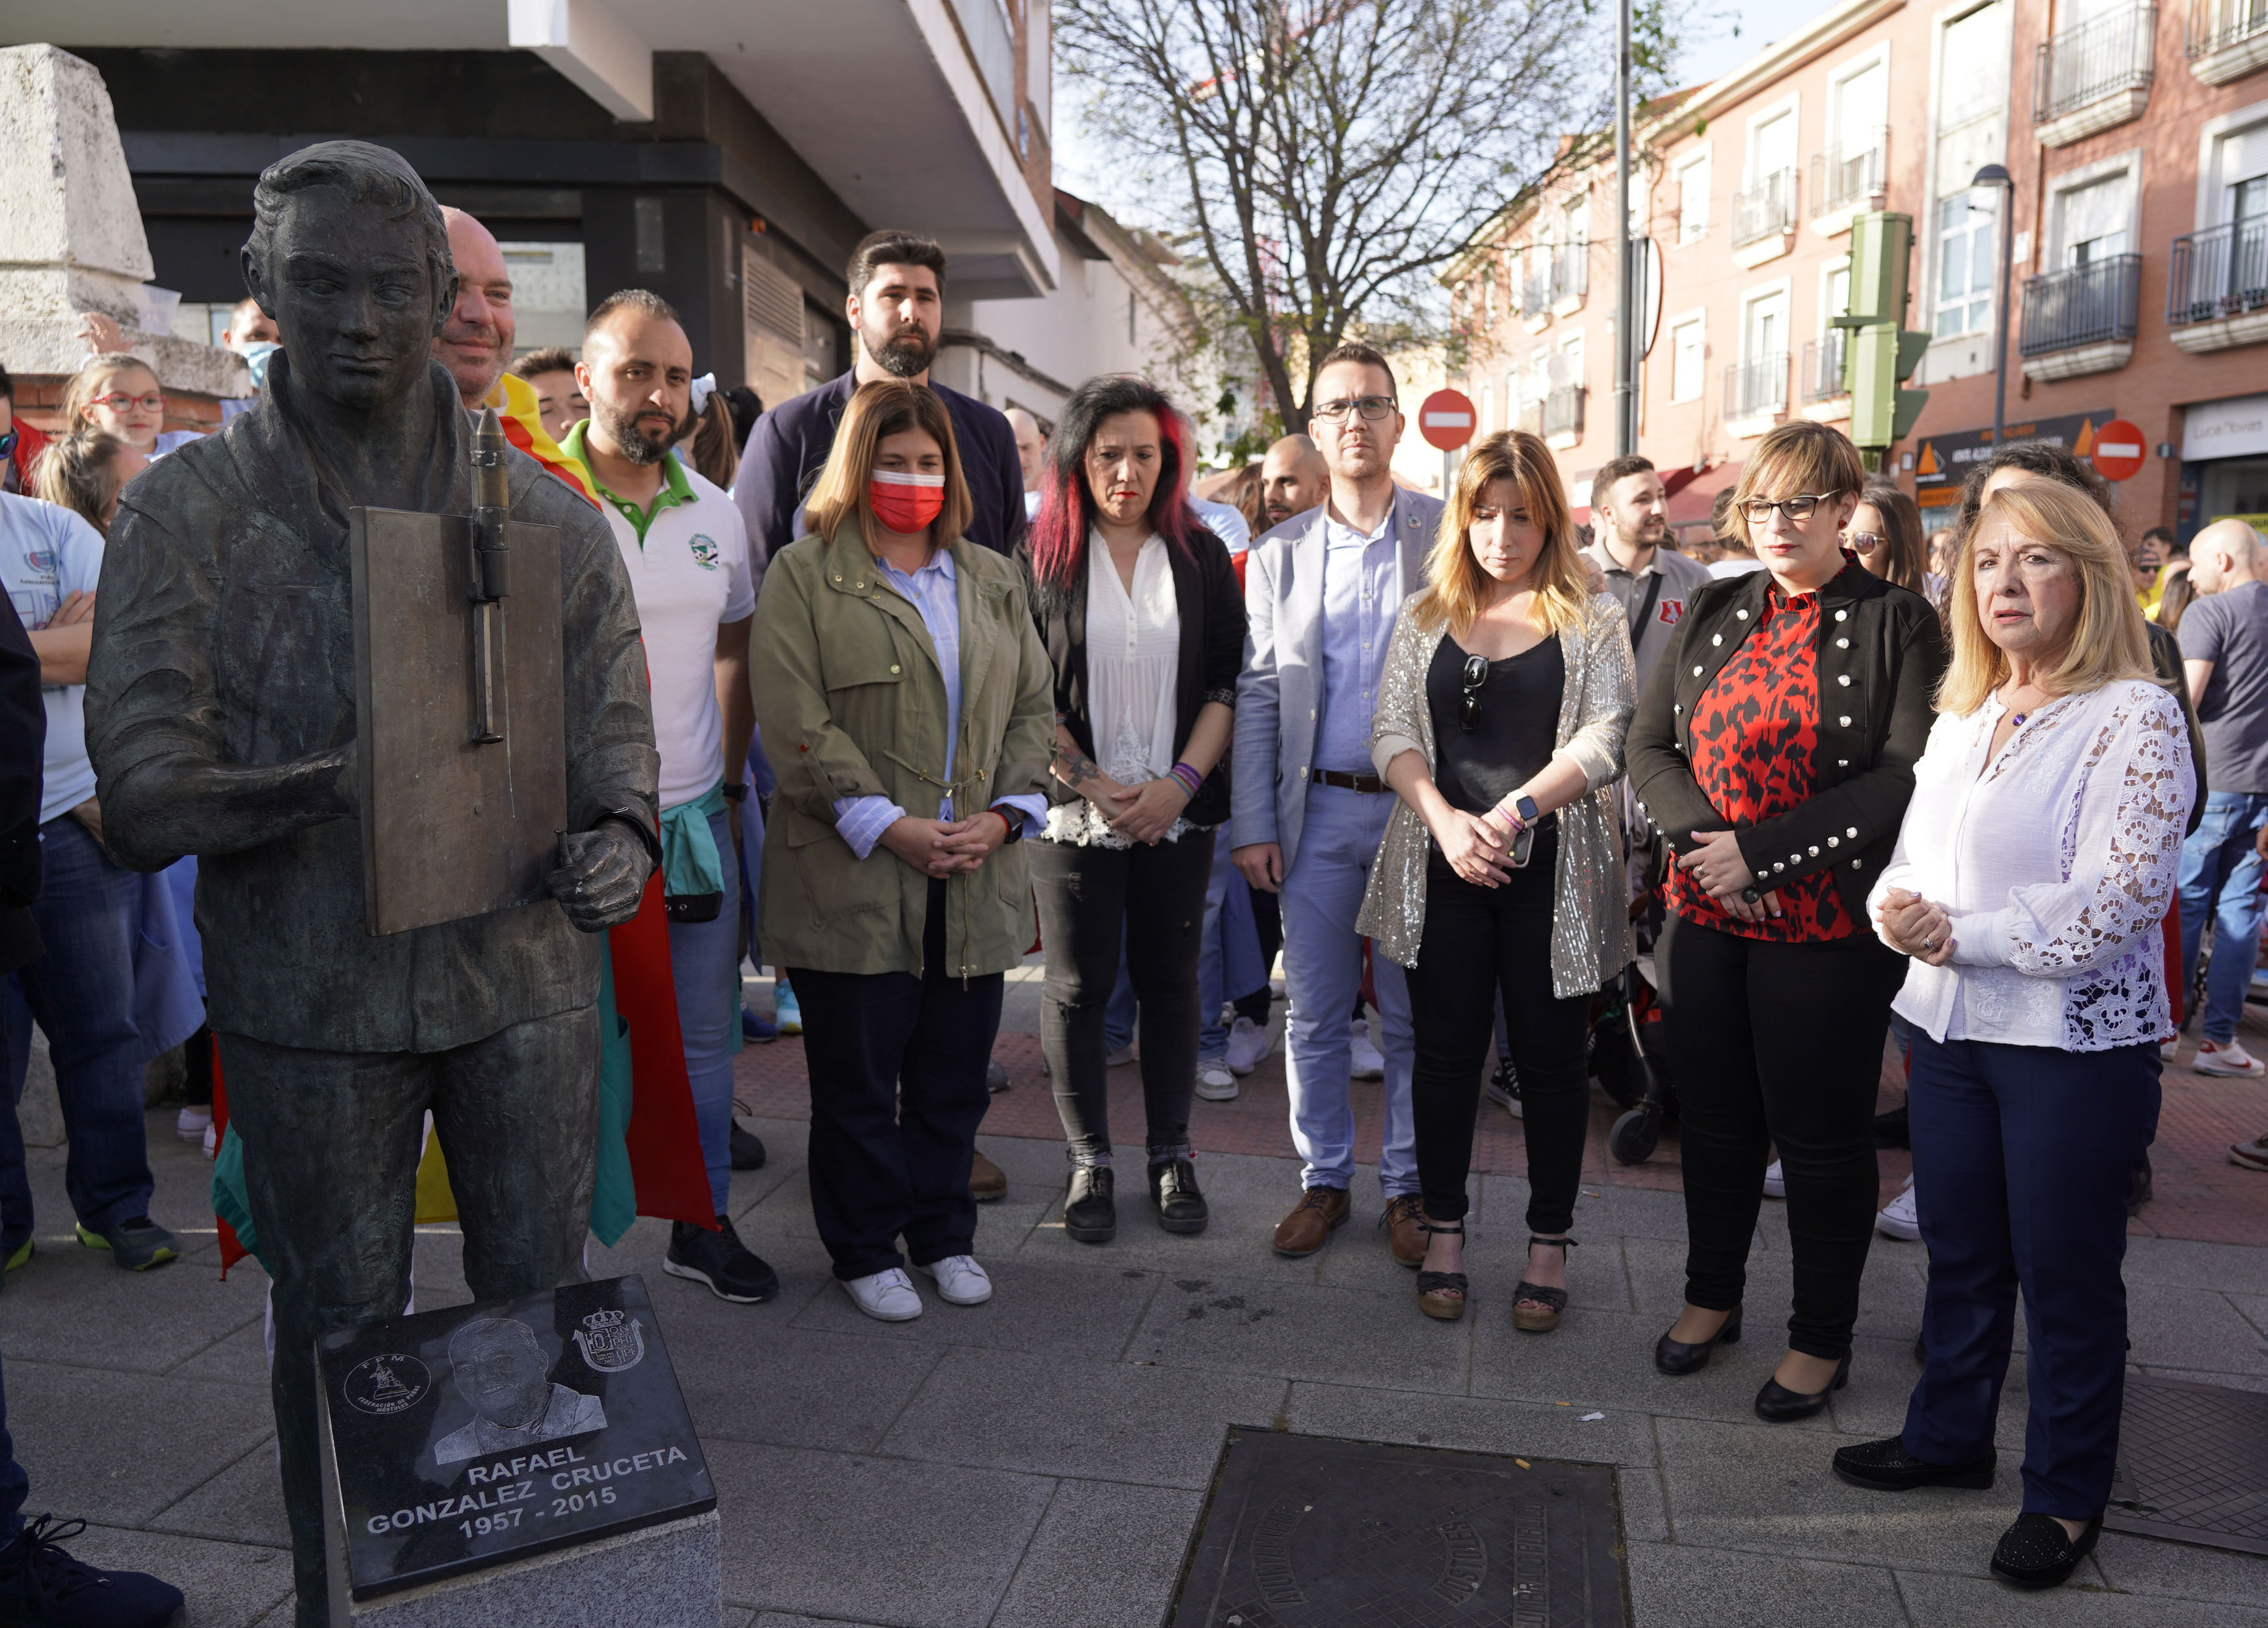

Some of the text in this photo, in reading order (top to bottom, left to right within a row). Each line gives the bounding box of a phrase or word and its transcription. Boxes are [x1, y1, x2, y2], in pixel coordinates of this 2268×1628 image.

[367, 1445, 688, 1535] GONZALEZ CRUCETA
[468, 1447, 585, 1486] RAFAEL
[458, 1506, 524, 1540] 1957
[551, 1486, 617, 1517] 2015
